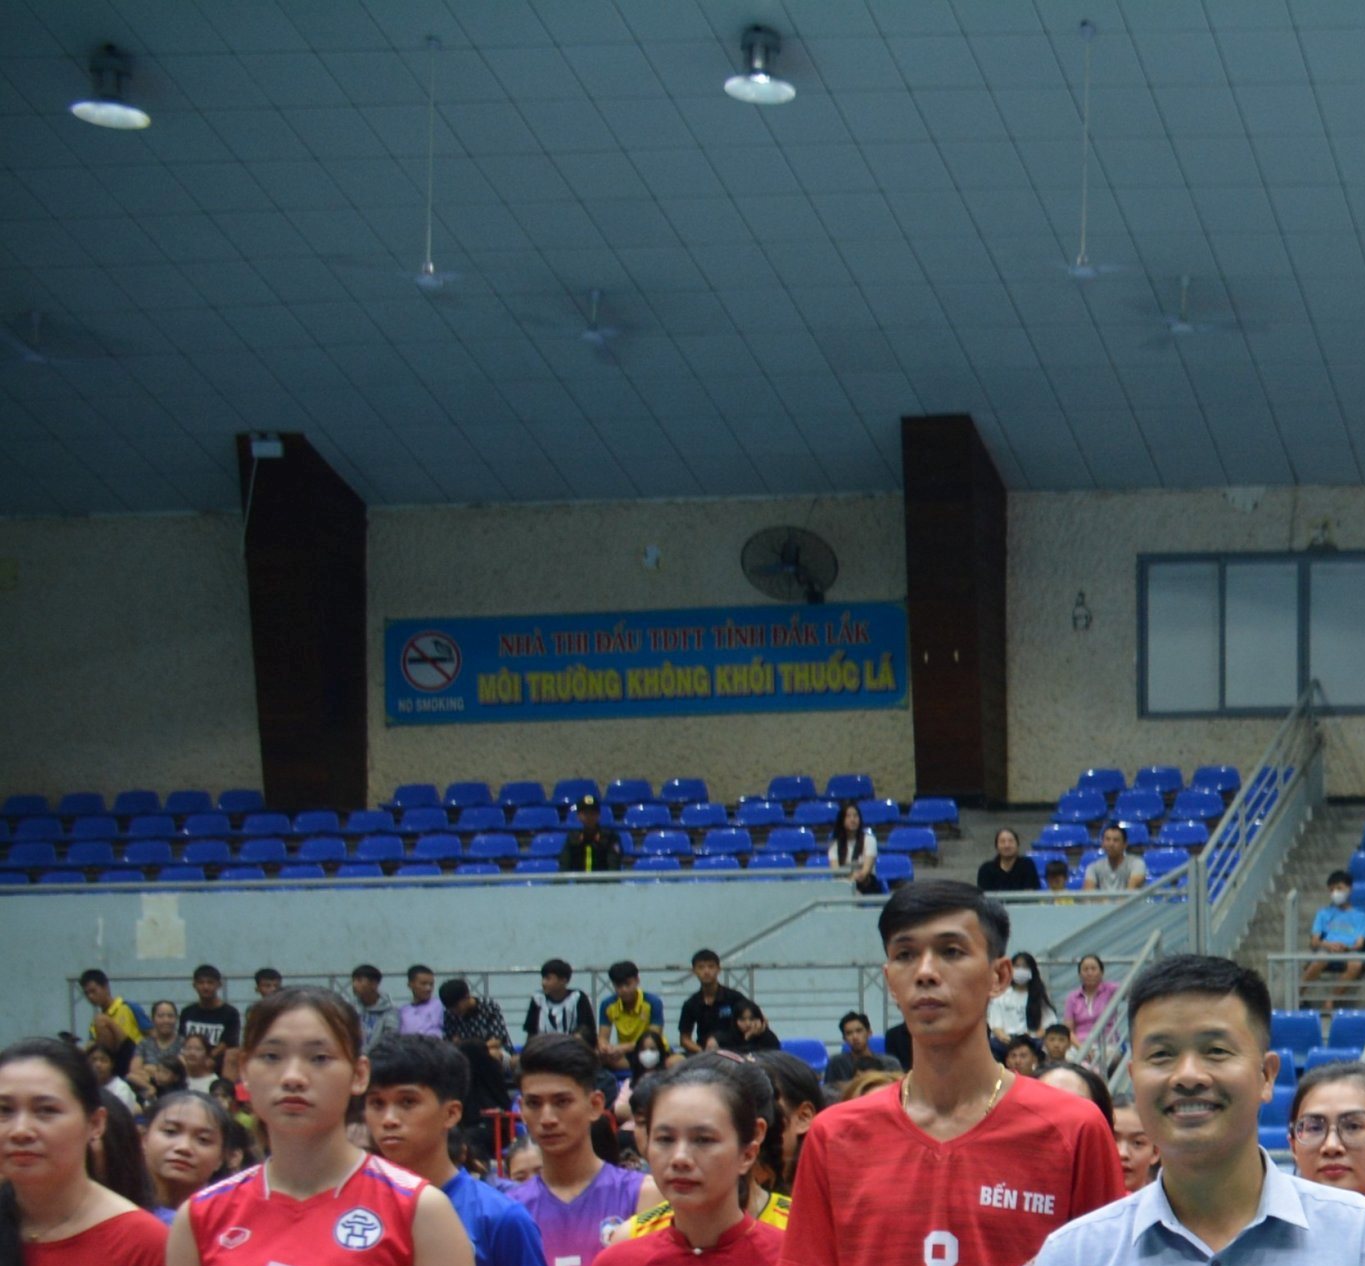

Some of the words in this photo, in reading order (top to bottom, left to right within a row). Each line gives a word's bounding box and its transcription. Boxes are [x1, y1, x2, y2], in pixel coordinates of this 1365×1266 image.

[552, 629, 588, 655] THI
[594, 618, 643, 654] ĐẤU
[648, 627, 705, 652] TDTT
[478, 666, 523, 704] MÔI
[525, 662, 623, 703] TRƯỜNG
[626, 659, 711, 700] KHÔNG
[778, 649, 860, 694] THUỐC
[398, 698, 413, 712] NO
[416, 696, 464, 711] SMOKING
[978, 1181, 1018, 1208] BẾN
[1022, 1192, 1056, 1216] TRE
